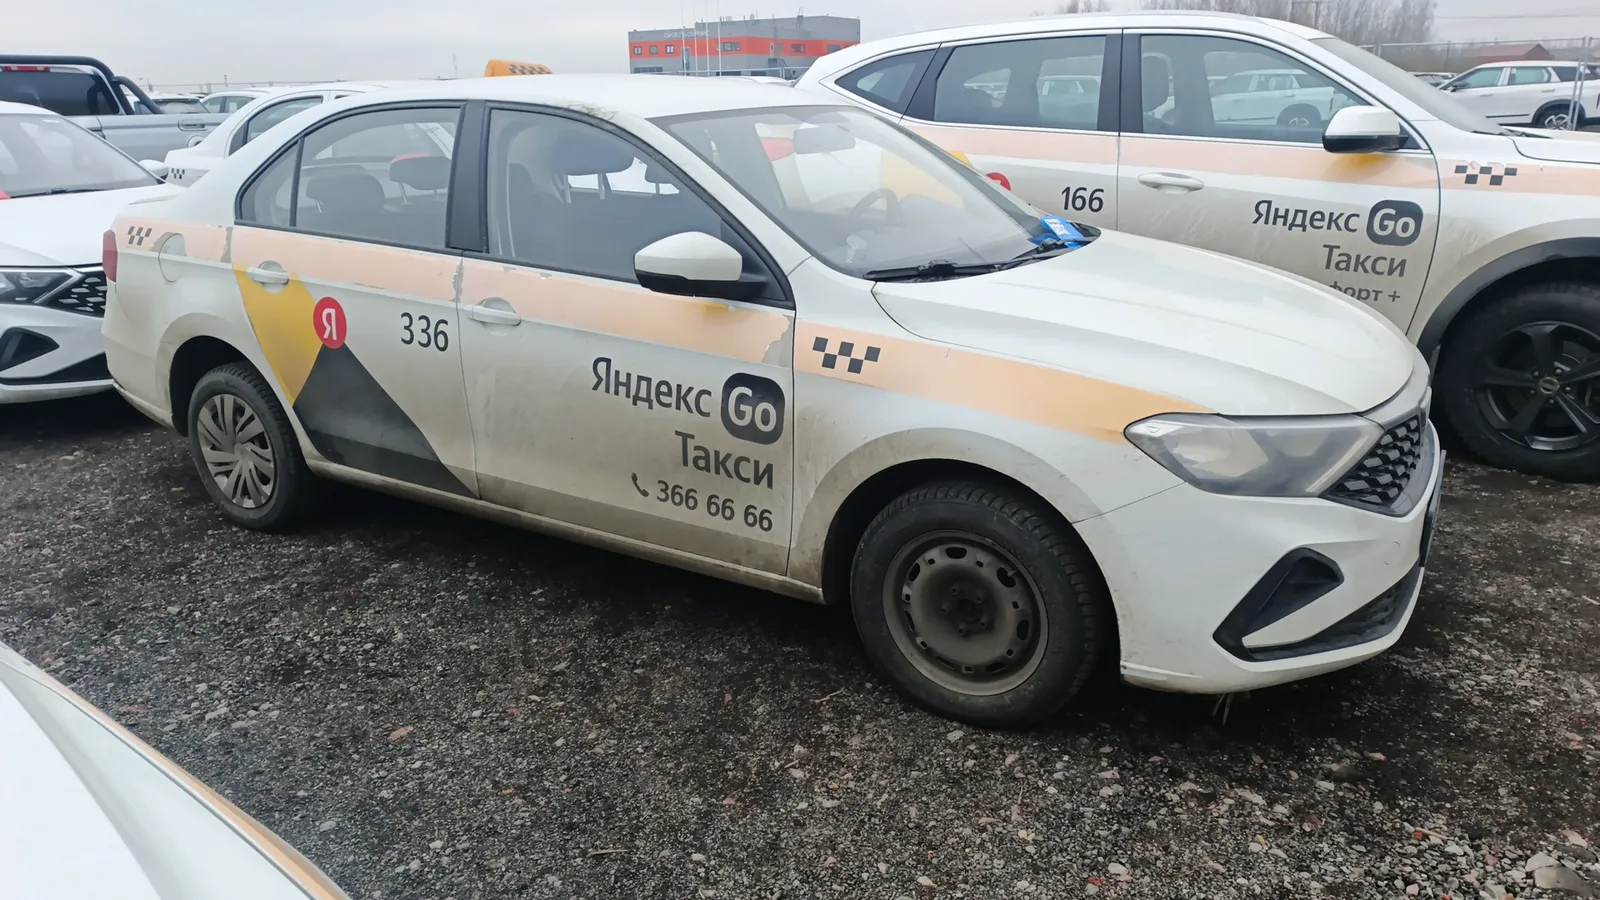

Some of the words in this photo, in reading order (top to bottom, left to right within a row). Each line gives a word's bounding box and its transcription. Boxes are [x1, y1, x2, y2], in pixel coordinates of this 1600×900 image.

[1061, 186, 1105, 213] 166
[1252, 199, 1360, 233] Яндекс
[1372, 207, 1416, 238] Go
[1323, 244, 1407, 278] Такси
[321, 307, 337, 341] Я
[400, 311, 449, 352] 336
[591, 356, 712, 418] Яндекс
[727, 386, 777, 433] Go
[674, 430, 773, 490] Такси
[656, 480, 698, 511] 366
[706, 494, 735, 521] 66
[743, 504, 773, 532] 66
